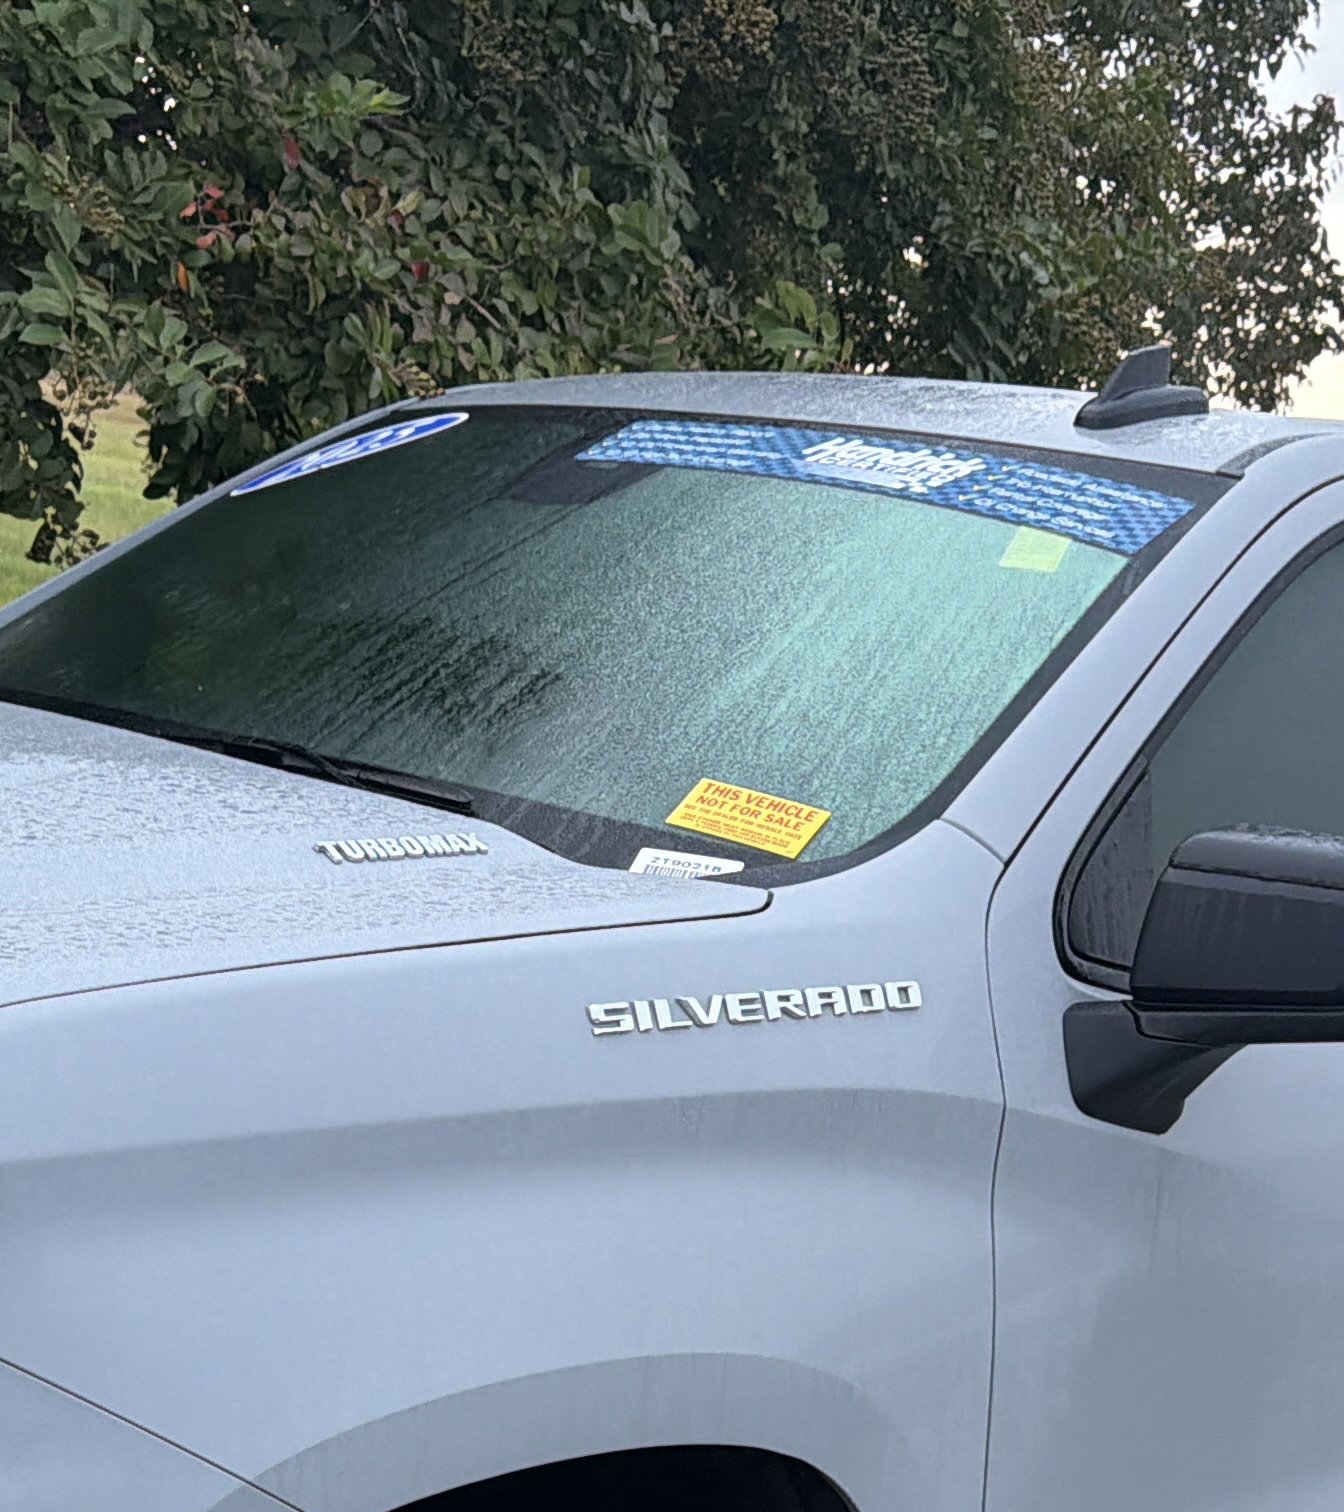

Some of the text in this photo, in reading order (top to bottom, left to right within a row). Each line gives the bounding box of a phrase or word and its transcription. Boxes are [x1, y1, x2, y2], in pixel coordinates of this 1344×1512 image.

[801, 436, 988, 479] Hendrick
[694, 794, 728, 809] NOT
[728, 803, 763, 819] FOR
[762, 813, 805, 831] SALE
[700, 781, 820, 822] THIS VEHICLE
[313, 832, 489, 865] TURBOMAX
[587, 980, 923, 1036] SILVERADO
